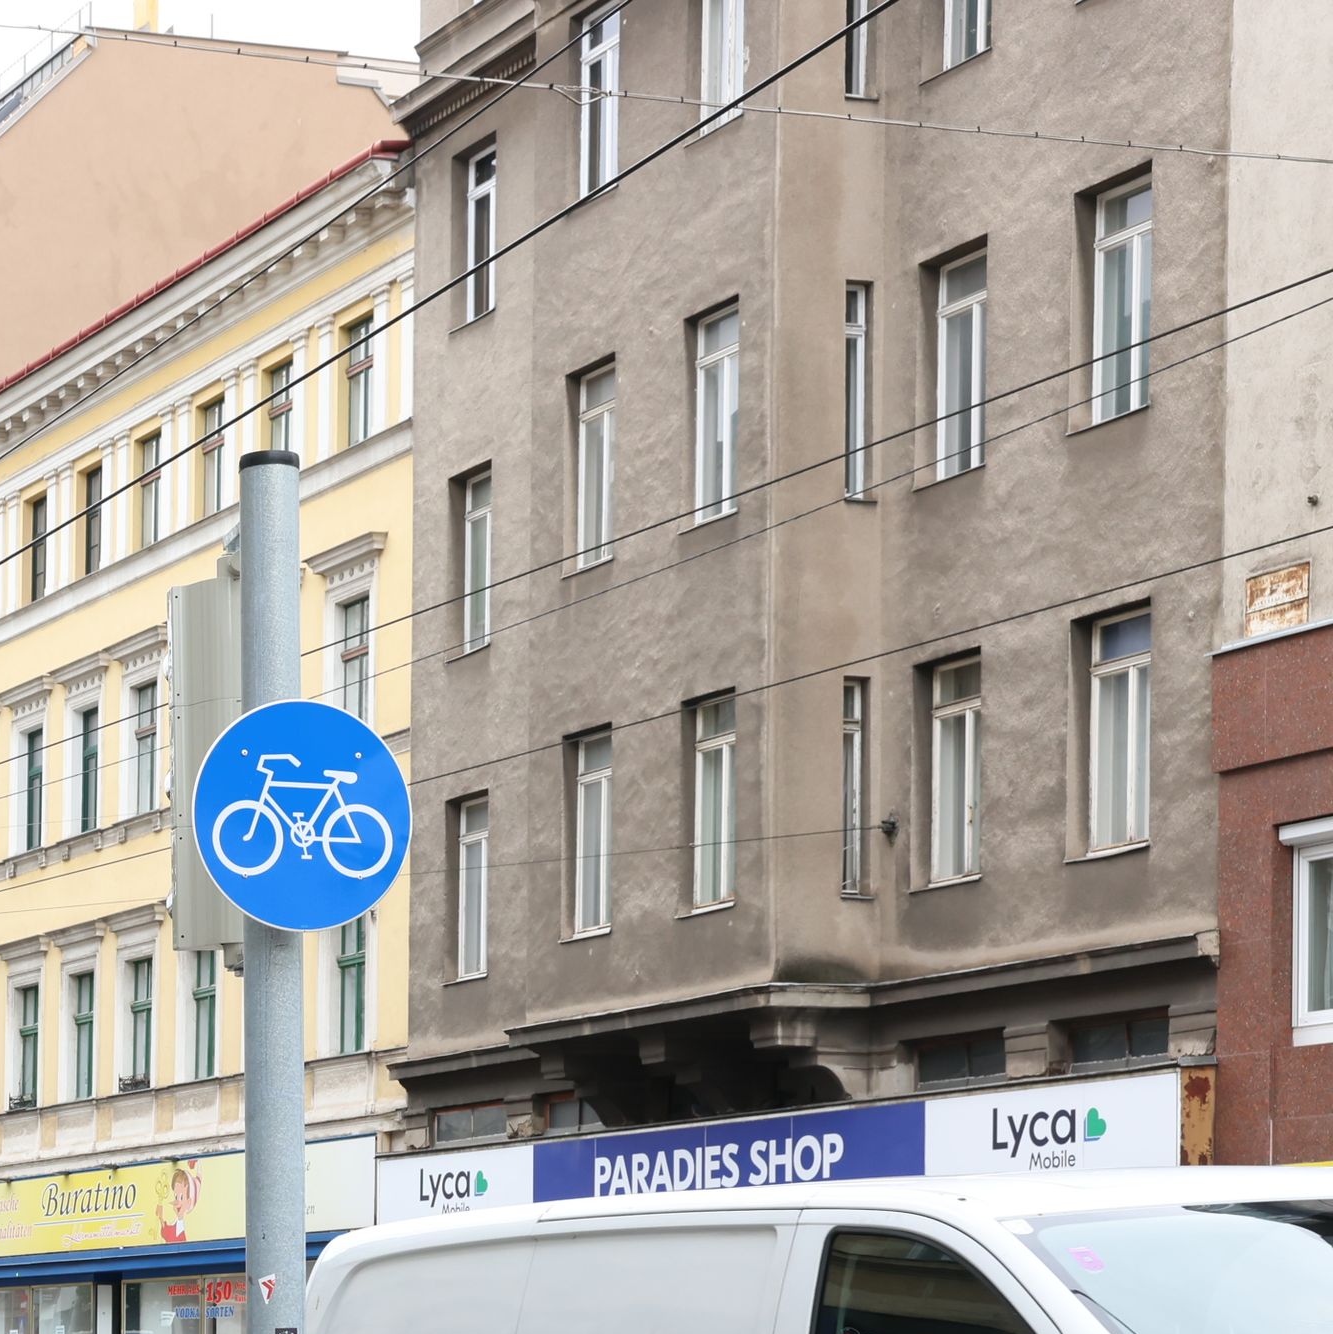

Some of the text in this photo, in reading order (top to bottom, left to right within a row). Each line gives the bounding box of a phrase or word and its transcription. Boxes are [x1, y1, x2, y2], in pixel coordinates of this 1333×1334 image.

[991, 1107, 1077, 1158] Lyca
[594, 1133, 844, 1197] PARADIES SHOP
[1029, 1150, 1077, 1171] Mobile
[42, 1175, 137, 1217] Buratino
[419, 1168, 471, 1208] Lyca
[206, 1280, 233, 1303] 150
[175, 1305, 235, 1319] VODKA SORTEN
